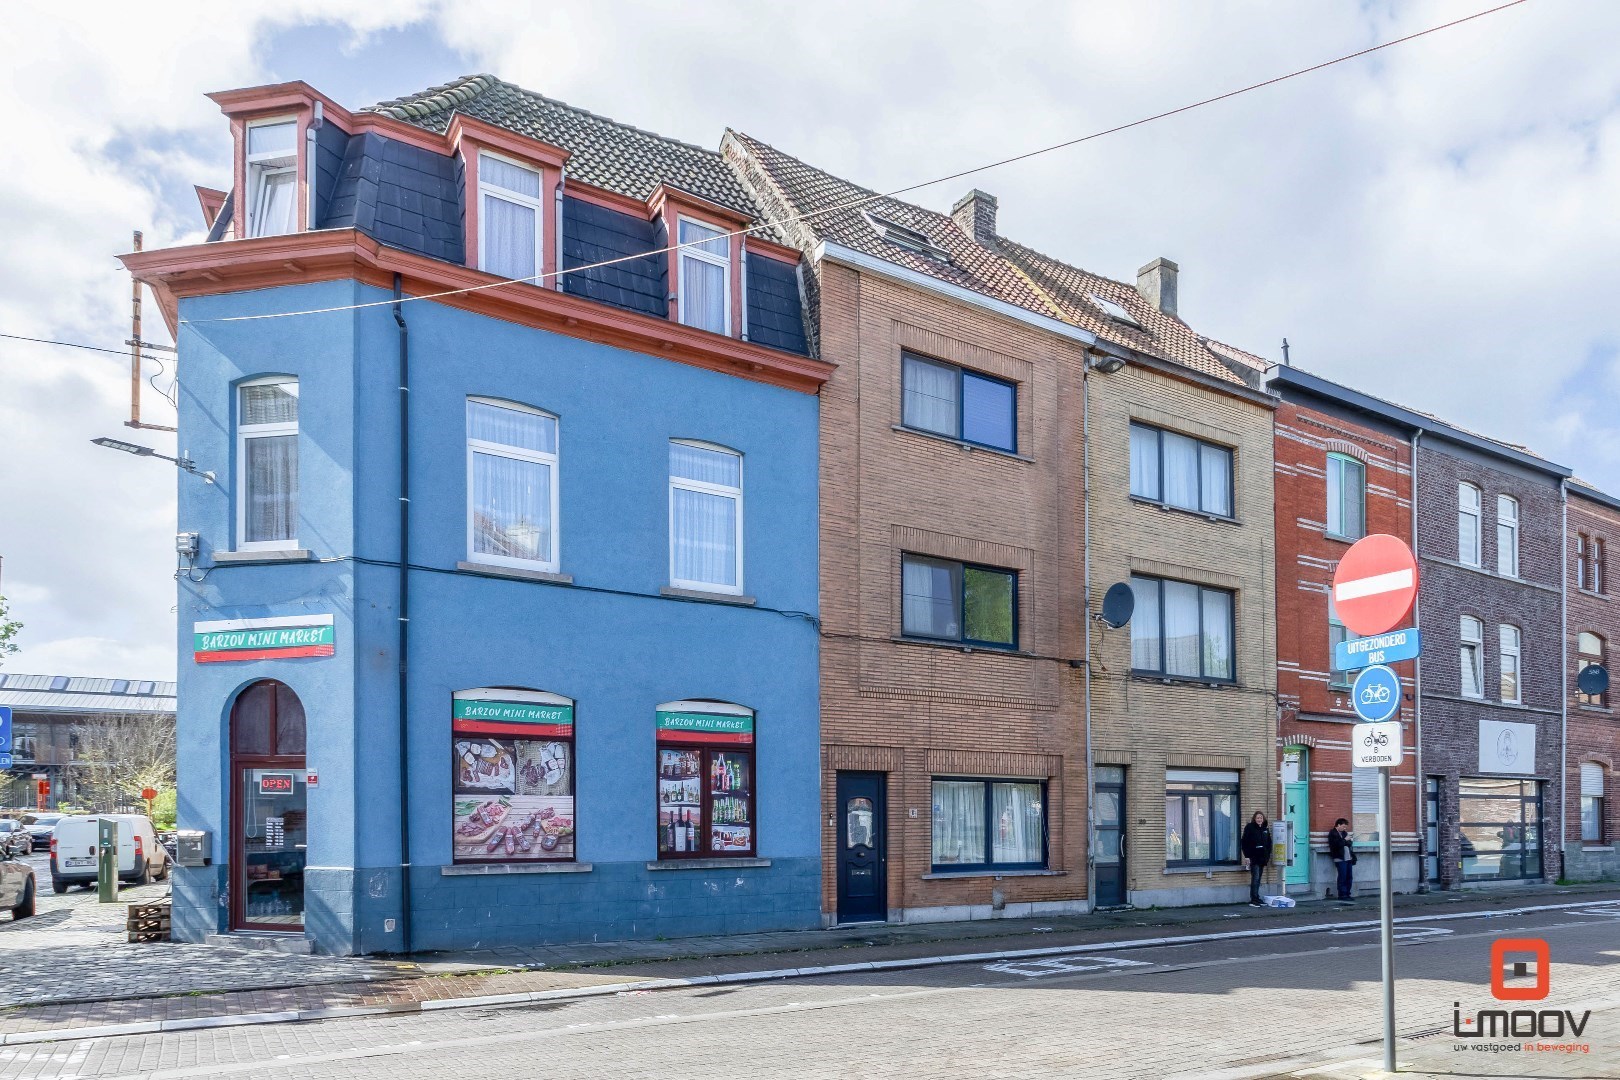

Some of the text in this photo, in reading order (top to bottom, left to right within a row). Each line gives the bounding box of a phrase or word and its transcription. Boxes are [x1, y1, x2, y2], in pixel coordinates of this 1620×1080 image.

[201, 628, 328, 650] BARZOV MINI MARKET
[1347, 633, 1406, 655] UITGEZONDERD
[1368, 650, 1385, 664] BUS
[465, 706, 562, 720] BARZOV MINI MARKET
[664, 717, 744, 729] BARZOV MINI MARKET
[0, 757, 11, 765] EN
[1361, 755, 1392, 763] VERBODEN
[262, 779, 291, 789] OPEN
